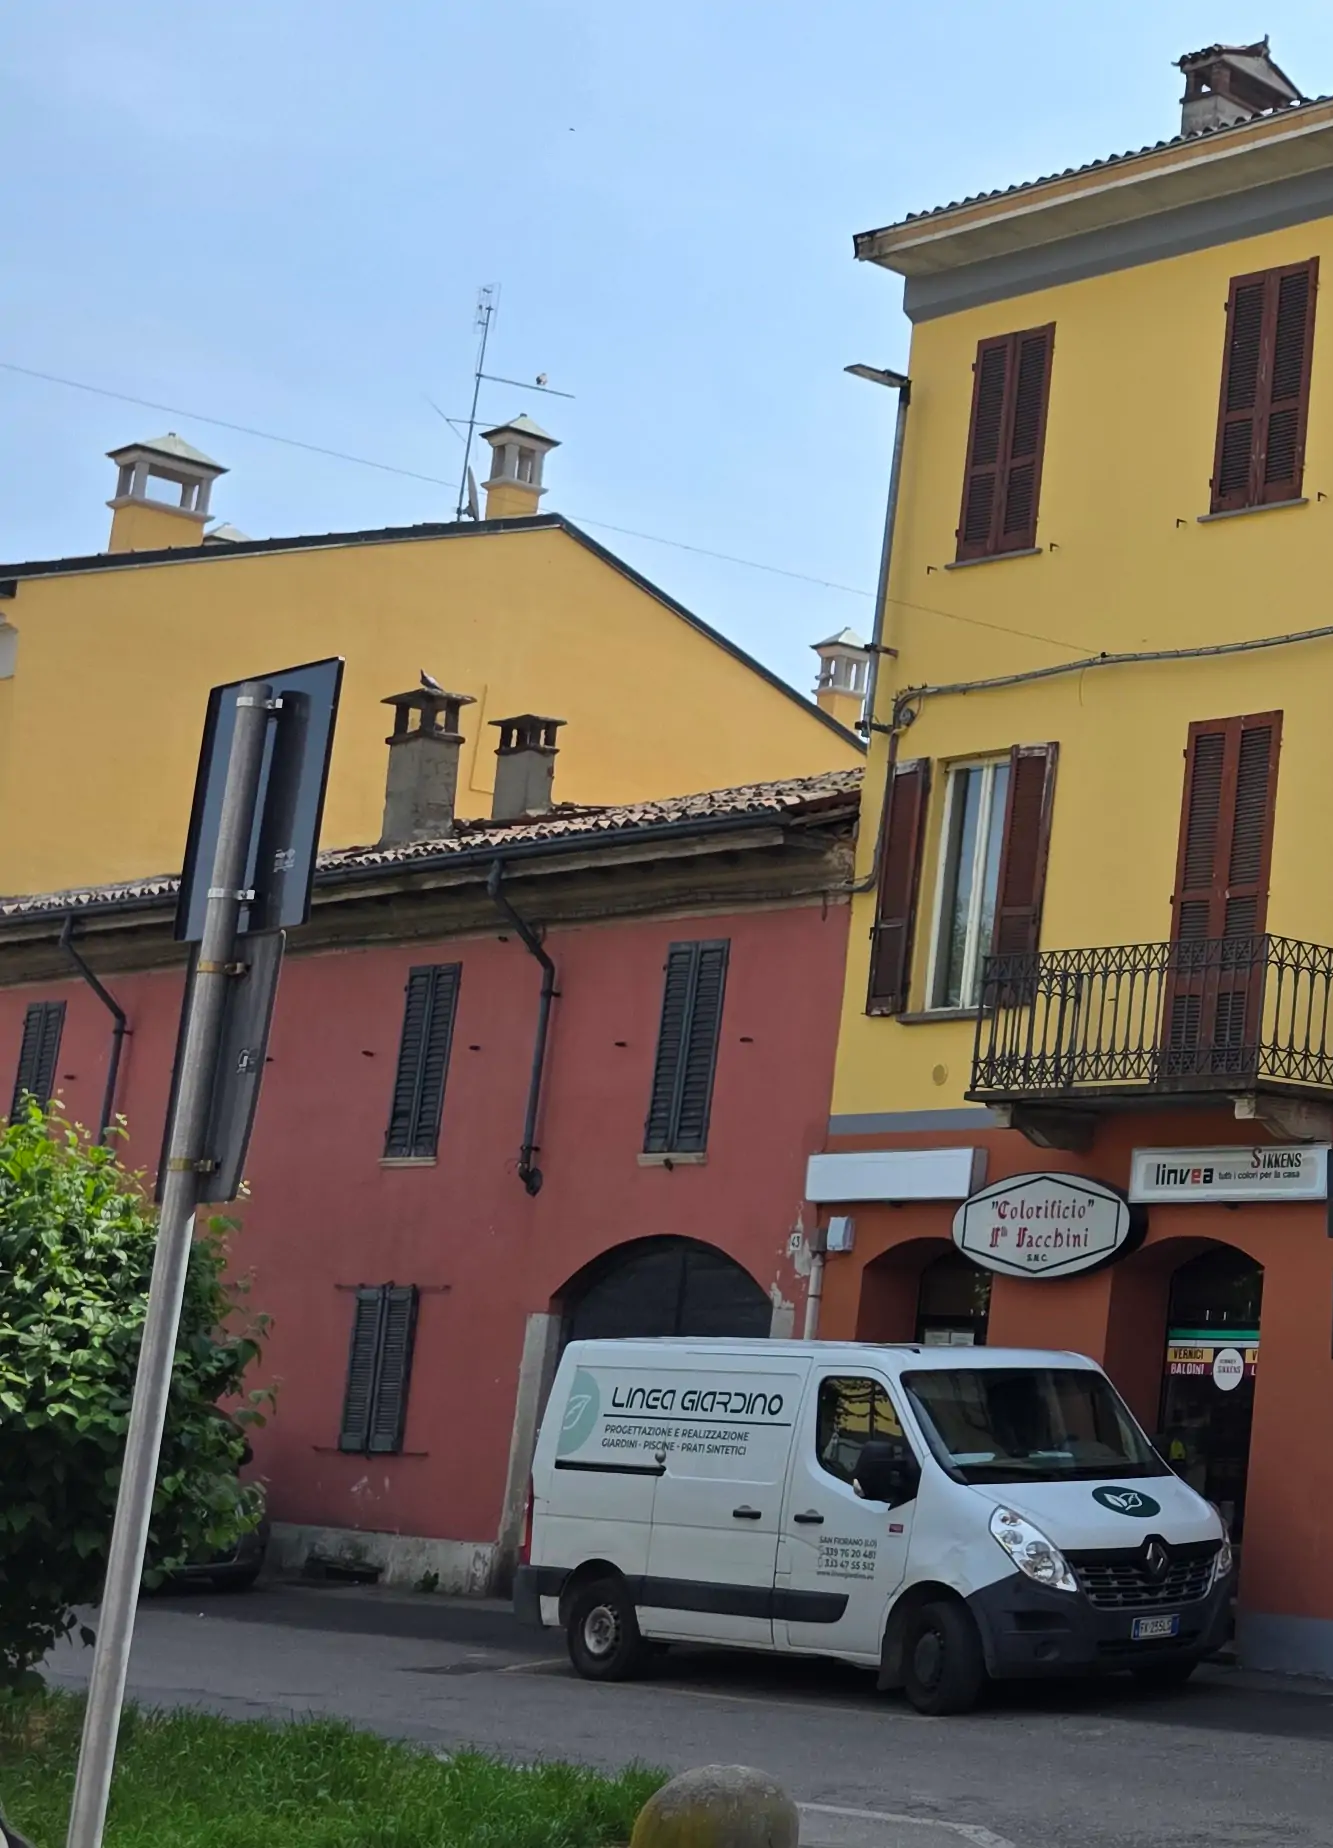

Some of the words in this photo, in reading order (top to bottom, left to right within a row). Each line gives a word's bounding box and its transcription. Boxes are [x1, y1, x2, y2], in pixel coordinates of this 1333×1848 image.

[1251, 1148, 1302, 1169] SIKKENS
[1155, 1164, 1214, 1185] linvea
[1218, 1172, 1232, 1180] tutti
[1238, 1171, 1258, 1179] colori
[1259, 1171, 1271, 1180] per
[1282, 1171, 1300, 1179] casa
[791, 1235, 801, 1248] 43
[1173, 1349, 1204, 1360] VERNICI
[1170, 1363, 1205, 1375] BALDINI
[611, 1386, 676, 1411] LINEA
[680, 1390, 783, 1415] GIARDINO
[604, 1424, 673, 1438] PROGETTAZIONE
[674, 1428, 680, 1438] E
[681, 1428, 750, 1441] REALIZZAZIONE
[601, 1438, 637, 1449] GIARDINI
[643, 1442, 675, 1452] PISCINE
[681, 1443, 705, 1454] PRATI
[706, 1444, 746, 1456] SINTETICI
[819, 1535, 833, 1544] SAN
[840, 1548, 849, 1558] 76
[851, 1549, 861, 1558] 20
[840, 1560, 849, 1569] 47
[851, 1561, 860, 1570] 55
